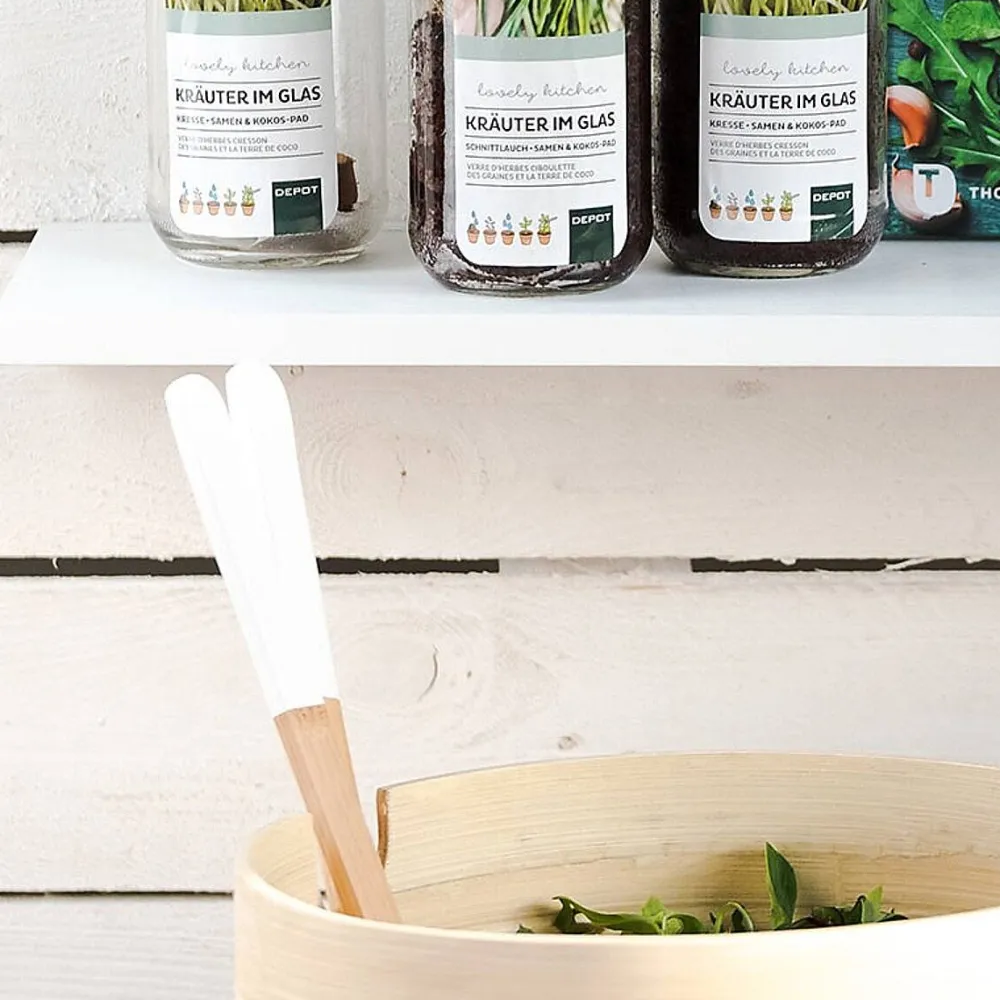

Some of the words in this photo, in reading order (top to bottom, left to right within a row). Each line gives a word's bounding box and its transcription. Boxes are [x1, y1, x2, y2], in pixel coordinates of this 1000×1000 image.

[241, 55, 310, 72] kitchen
[722, 60, 781, 80] lovely
[787, 60, 849, 76] kitchen
[175, 85, 249, 105] KRÄUTER
[253, 89, 273, 105] IM
[278, 85, 321, 104] GLAS
[477, 82, 537, 103] lovely
[543, 81, 607, 97] kitchen
[709, 89, 793, 109] KRÄUTER
[796, 94, 816, 109] IM
[820, 90, 856, 107] GLAS
[244, 116, 251, 126] &
[253, 114, 309, 126] KOKOS-PAD
[466, 112, 549, 132] KRÄUTER
[553, 115, 573, 132] IM
[578, 111, 615, 130] GLAS
[787, 122, 794, 131] &
[795, 119, 847, 130] KOKOS-PAD
[276, 142, 298, 152] COCO
[565, 142, 571, 151] &
[573, 138, 616, 151] KOKOS-PAD
[773, 141, 809, 150] CRESSON
[769, 150, 780, 158] LA
[781, 149, 804, 158] TERRE
[805, 148, 816, 157] DE
[817, 147, 837, 157] COCO
[466, 162, 489, 171] VERRE
[466, 170, 480, 180] DES
[515, 172, 525, 181] ET
[526, 172, 536, 180] LA
[537, 171, 561, 180] TERRE
[562, 170, 574, 180] DE
[574, 169, 595, 179] COCO
[274, 184, 319, 197] DEPOT
[812, 190, 851, 202] DEPOT
[571, 212, 611, 225] DEPOT
